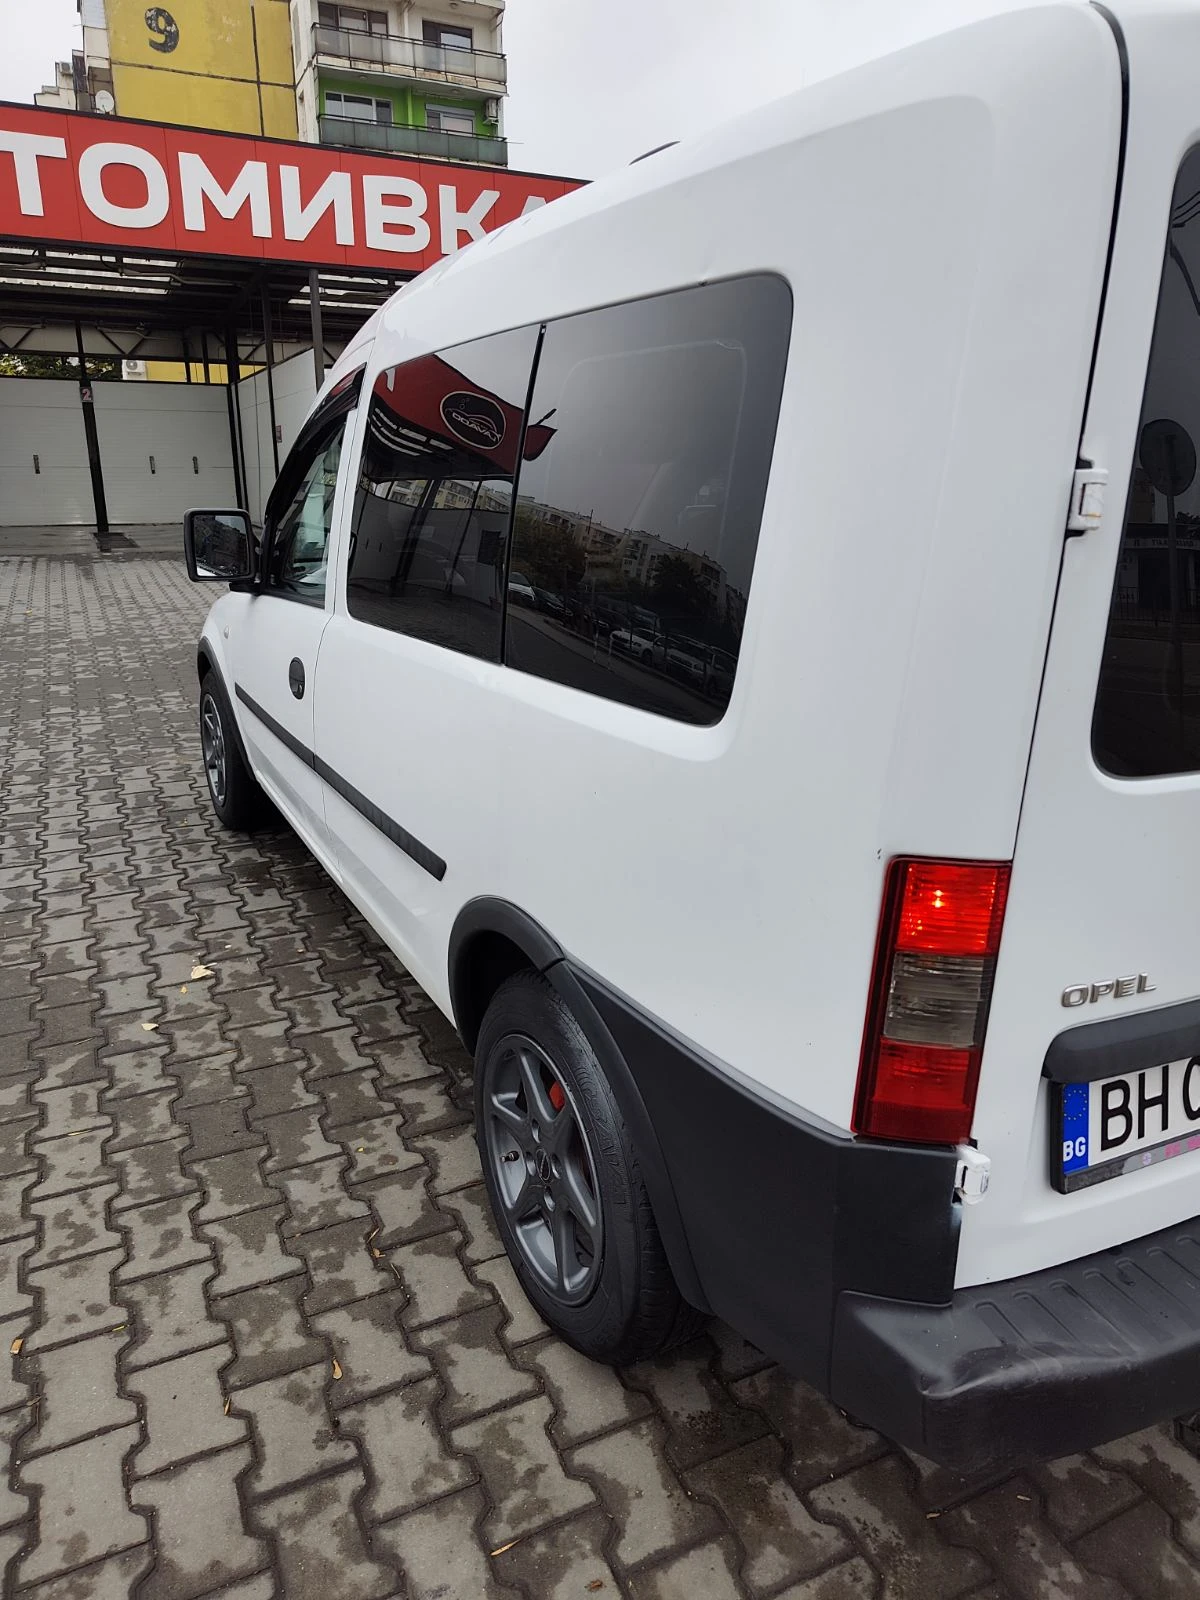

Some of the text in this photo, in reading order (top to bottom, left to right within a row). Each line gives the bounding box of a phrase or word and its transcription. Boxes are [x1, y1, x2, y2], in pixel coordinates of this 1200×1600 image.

[144, 6, 180, 54] 9
[0, 129, 547, 256] ТОМИВК
[81, 388, 92, 401] 2
[1061, 972, 1157, 1008] OPEL
[1062, 1136, 1087, 1162] BG
